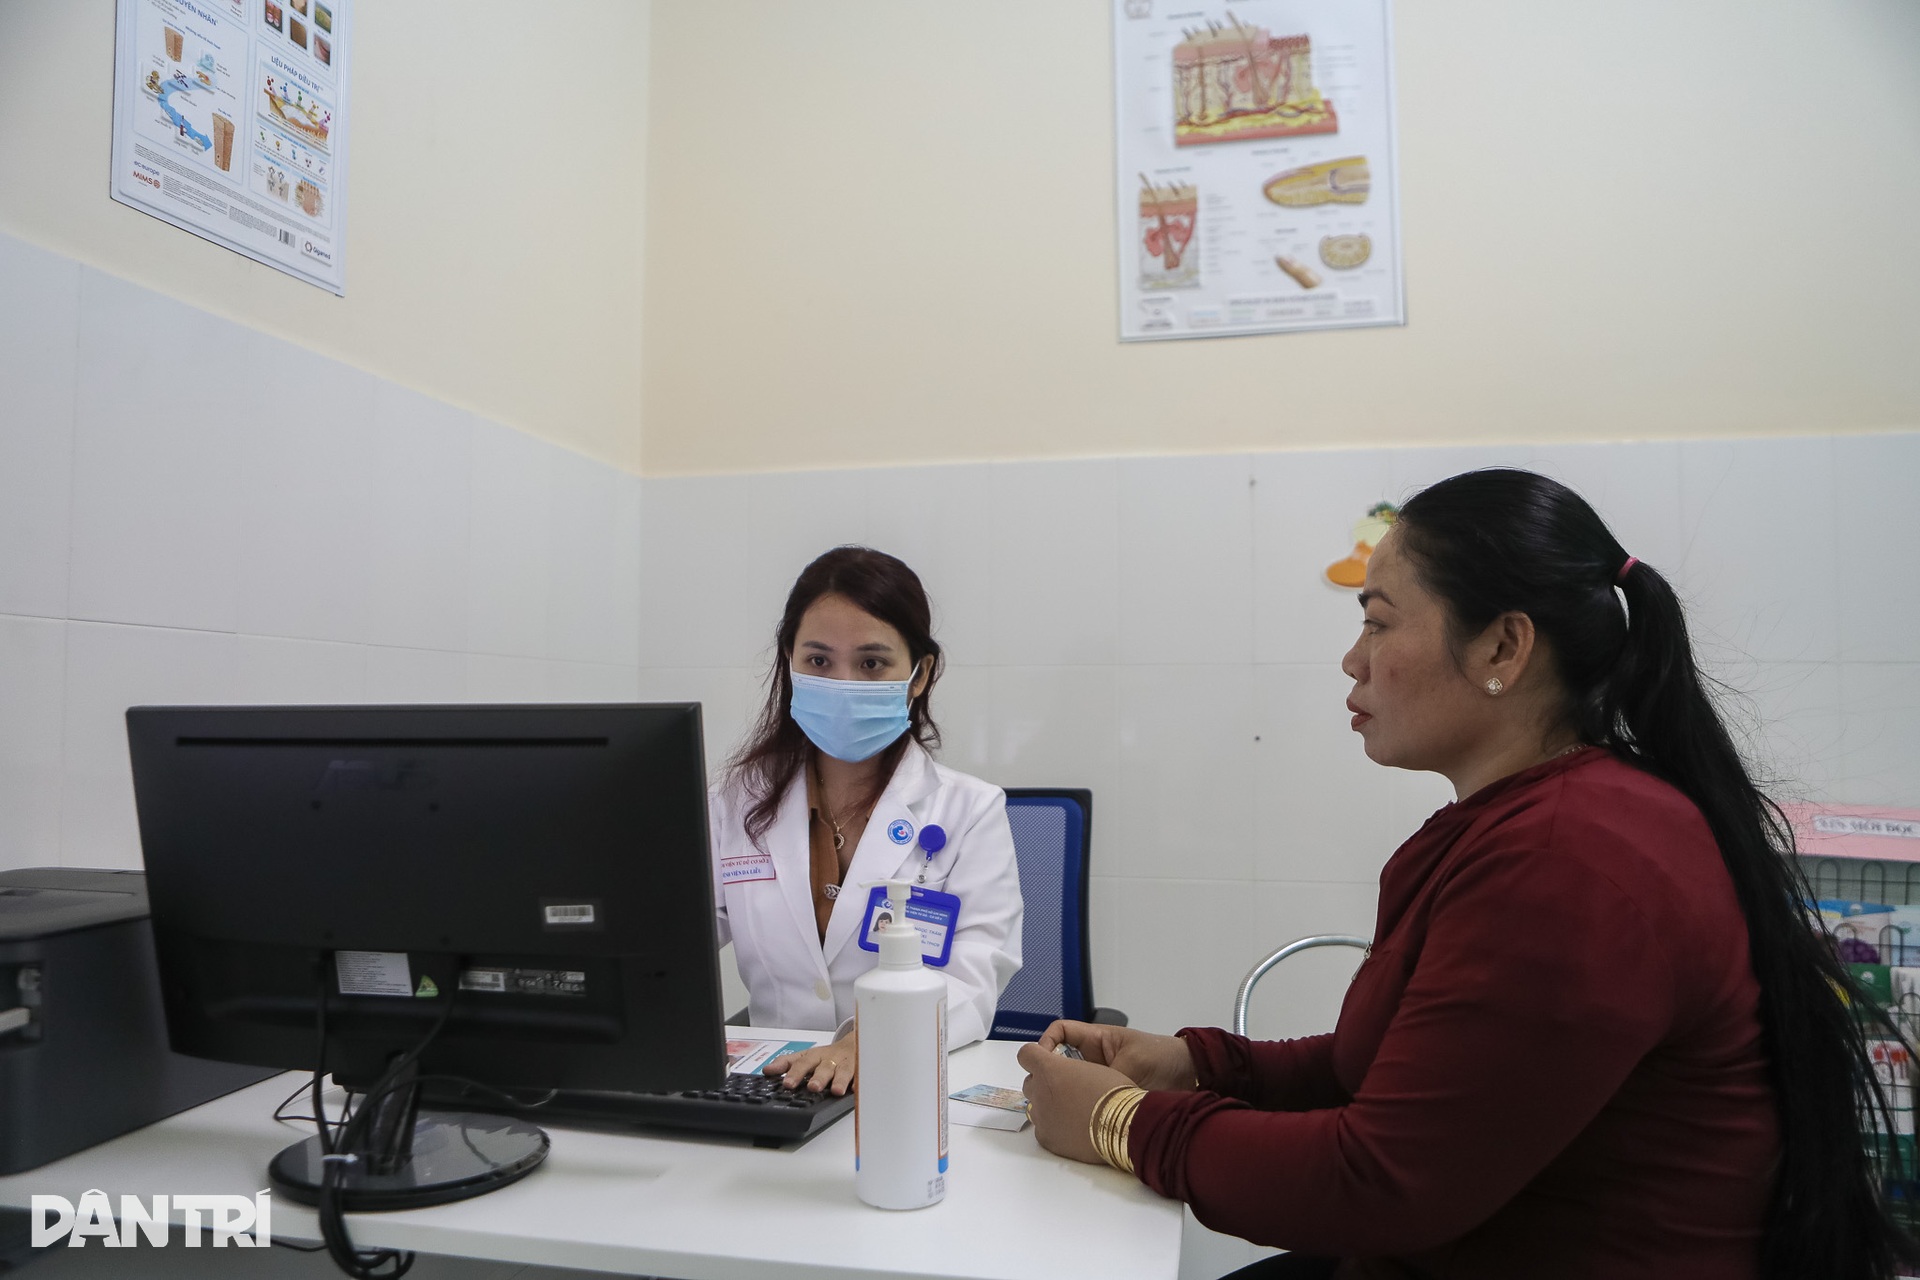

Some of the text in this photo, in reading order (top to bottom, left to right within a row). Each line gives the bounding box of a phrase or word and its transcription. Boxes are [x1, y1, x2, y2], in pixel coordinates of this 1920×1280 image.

[197, 9, 217, 26] NHÂN
[271, 56, 283, 68] LIỆU
[284, 63, 298, 77] PHÁP
[132, 170, 153, 185] MIMS
